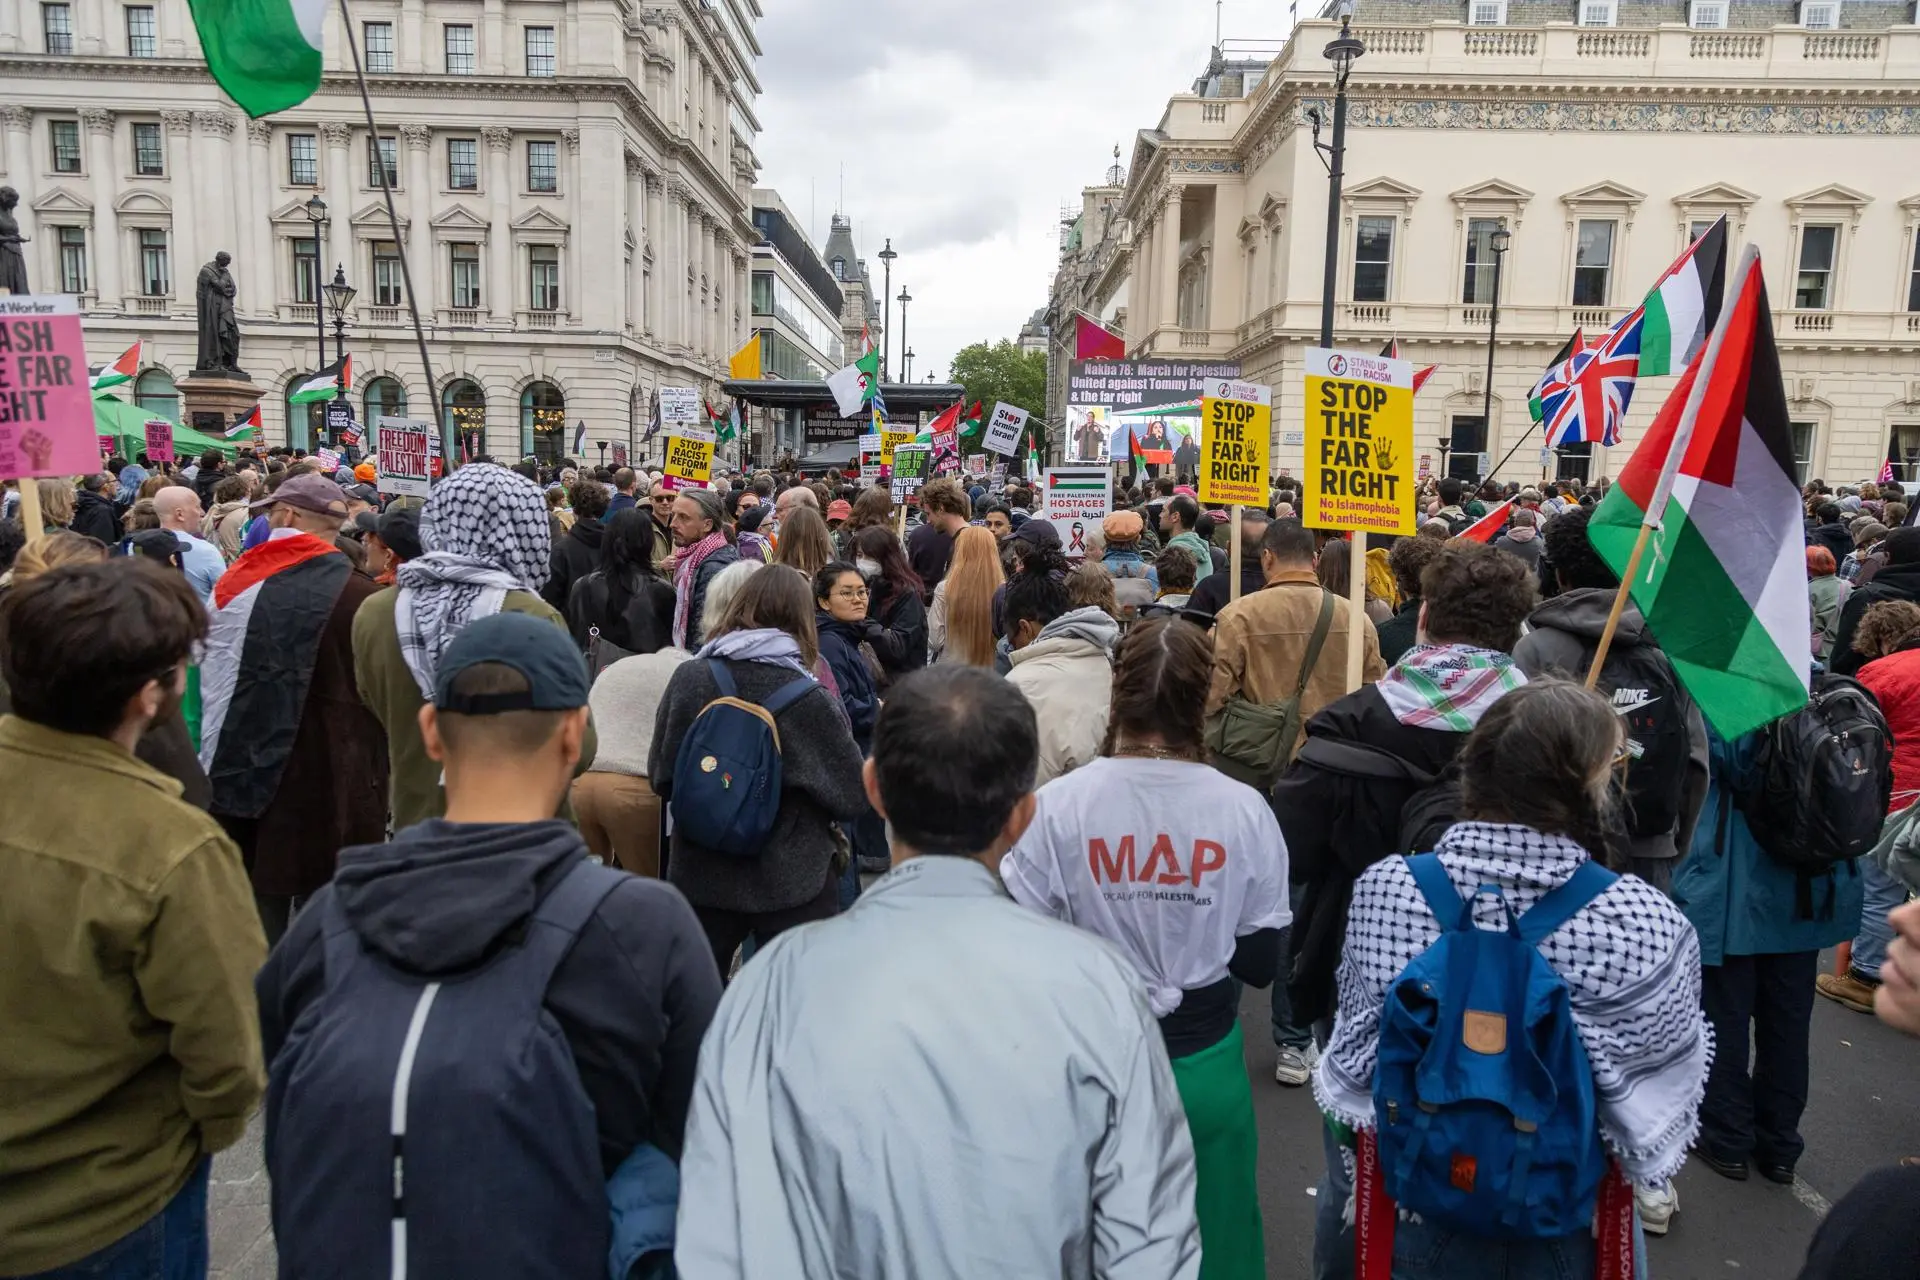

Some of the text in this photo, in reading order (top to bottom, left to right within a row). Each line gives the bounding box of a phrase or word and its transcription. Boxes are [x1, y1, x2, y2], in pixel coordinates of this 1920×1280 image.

[8, 302, 55, 313] Worker
[18, 356, 74, 386] FAR
[1085, 364, 1240, 376] Nakba 78: March for Palestine
[1350, 358, 1388, 371] STAND UP
[1351, 368, 1392, 383] TO RACISM
[1072, 377, 1106, 388] United
[1108, 378, 1147, 390] against
[1150, 379, 1188, 391] Tommy
[1072, 391, 1142, 404] & the far right
[1240, 393, 1258, 401] RACISM
[1321, 381, 1387, 412] STOP
[1212, 402, 1255, 422] STOP
[838, 428, 855, 436] right
[993, 420, 1019, 434] Arming
[1212, 422, 1244, 442] THE
[1320, 410, 1372, 440] THE
[380, 428, 427, 454] FREEDOM
[934, 433, 952, 445] UNITY
[992, 428, 1015, 440] Israel
[680, 439, 704, 450] STOP
[674, 447, 707, 461] RACIST
[1212, 442, 1242, 462] FAR
[1321, 439, 1370, 468] FAR
[380, 450, 427, 476] PALESTINE
[670, 456, 708, 470] REFORM
[940, 461, 958, 469] RACISM
[681, 468, 694, 477] UK
[895, 469, 904, 477] THE
[906, 469, 917, 477] SEA
[1211, 462, 1260, 483] RIGHT
[892, 478, 924, 486] PALESTINE
[1220, 483, 1260, 492] Islamophobia
[1321, 468, 1399, 500] RIGHT
[891, 487, 914, 495] WILL BE
[1220, 492, 1259, 502] antisemitism
[891, 495, 903, 503] FREE
[1320, 498, 1400, 515] No Islamophobia
[1320, 512, 1399, 528] No antisemitism
[1613, 688, 1648, 703] NIKE
[1088, 833, 1226, 888] MAP
[1137, 891, 1153, 900] FOR
